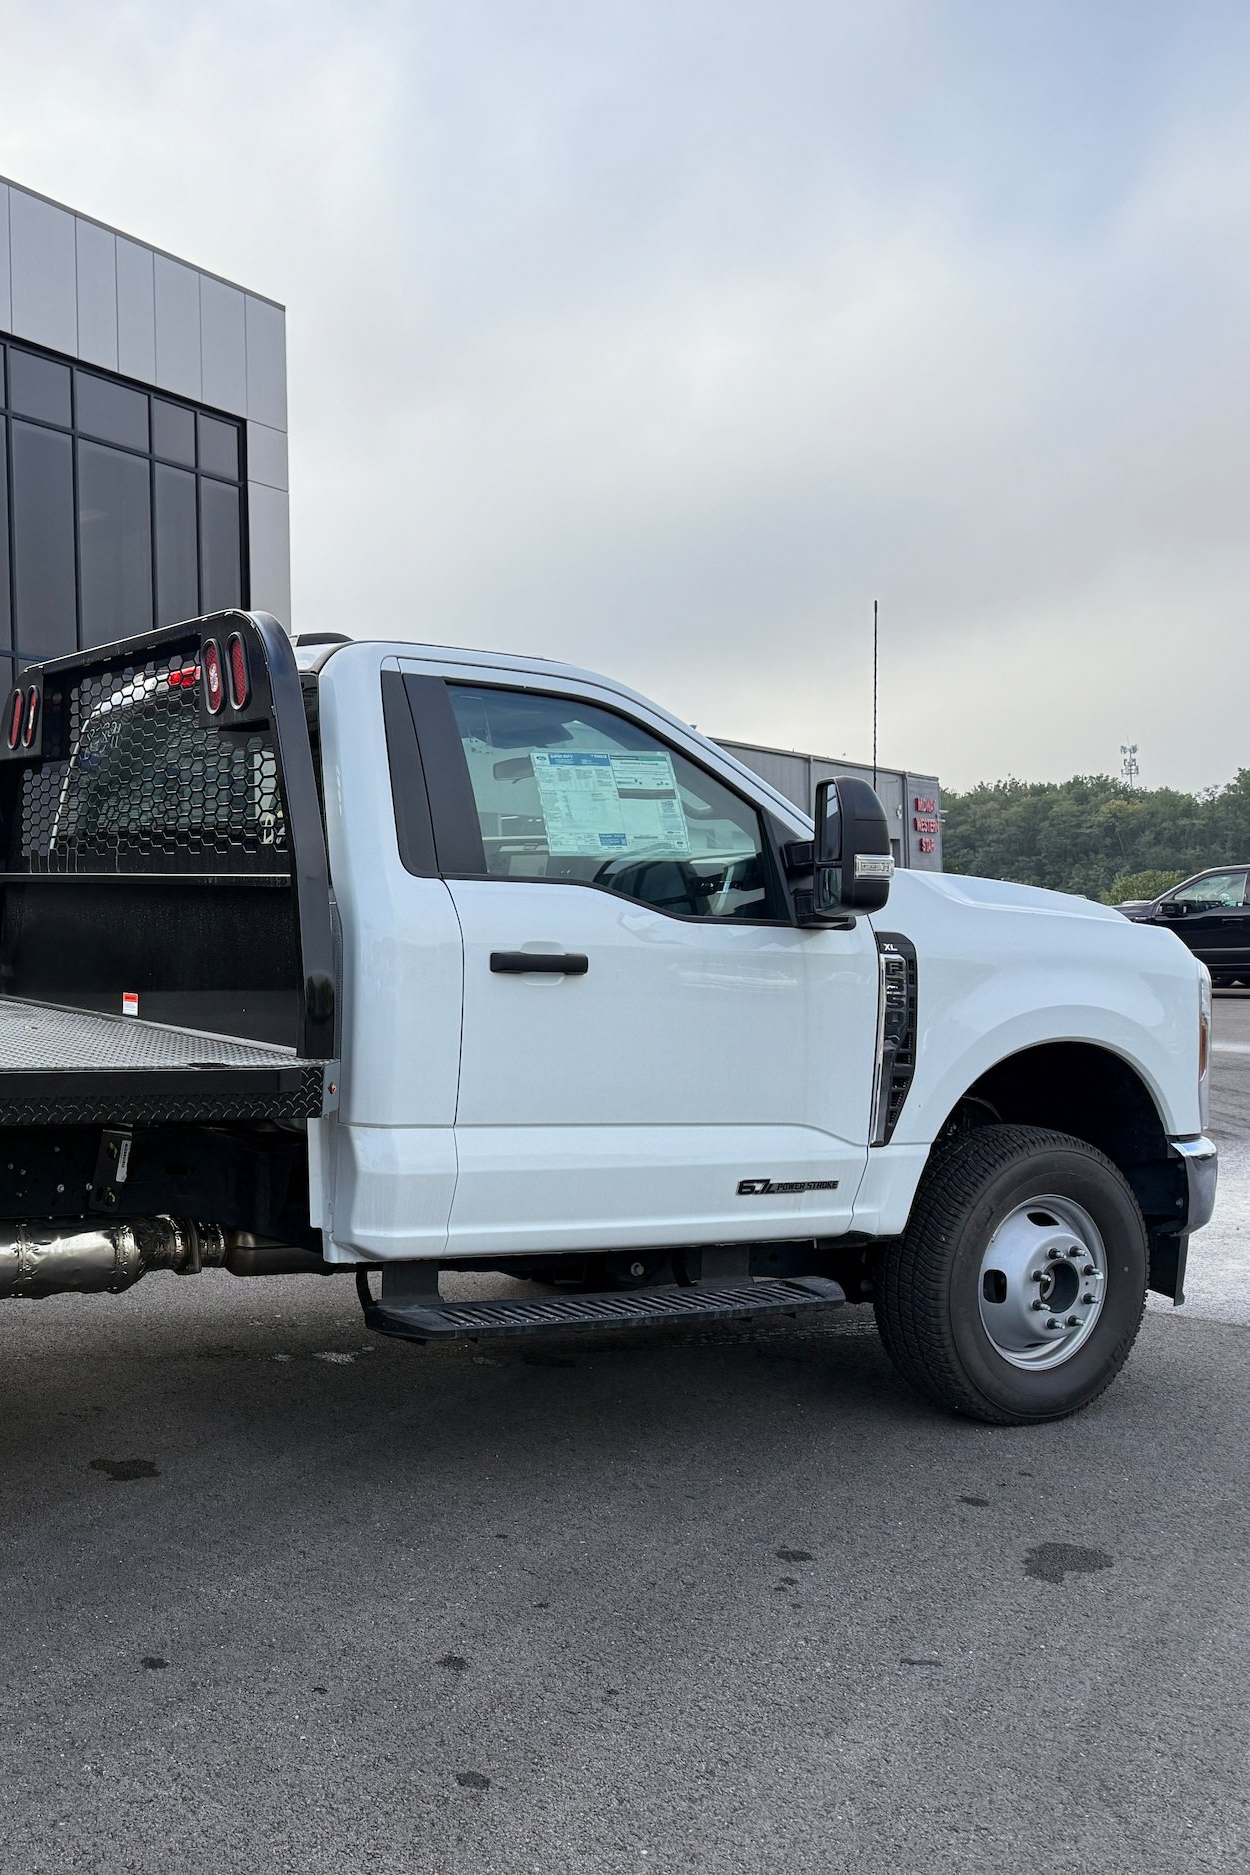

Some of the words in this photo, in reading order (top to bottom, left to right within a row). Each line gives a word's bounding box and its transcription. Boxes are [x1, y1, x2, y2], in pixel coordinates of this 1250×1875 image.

[883, 943, 898, 951] XL
[777, 1182, 805, 1191] POWER
[806, 1180, 839, 1190] STROKE
